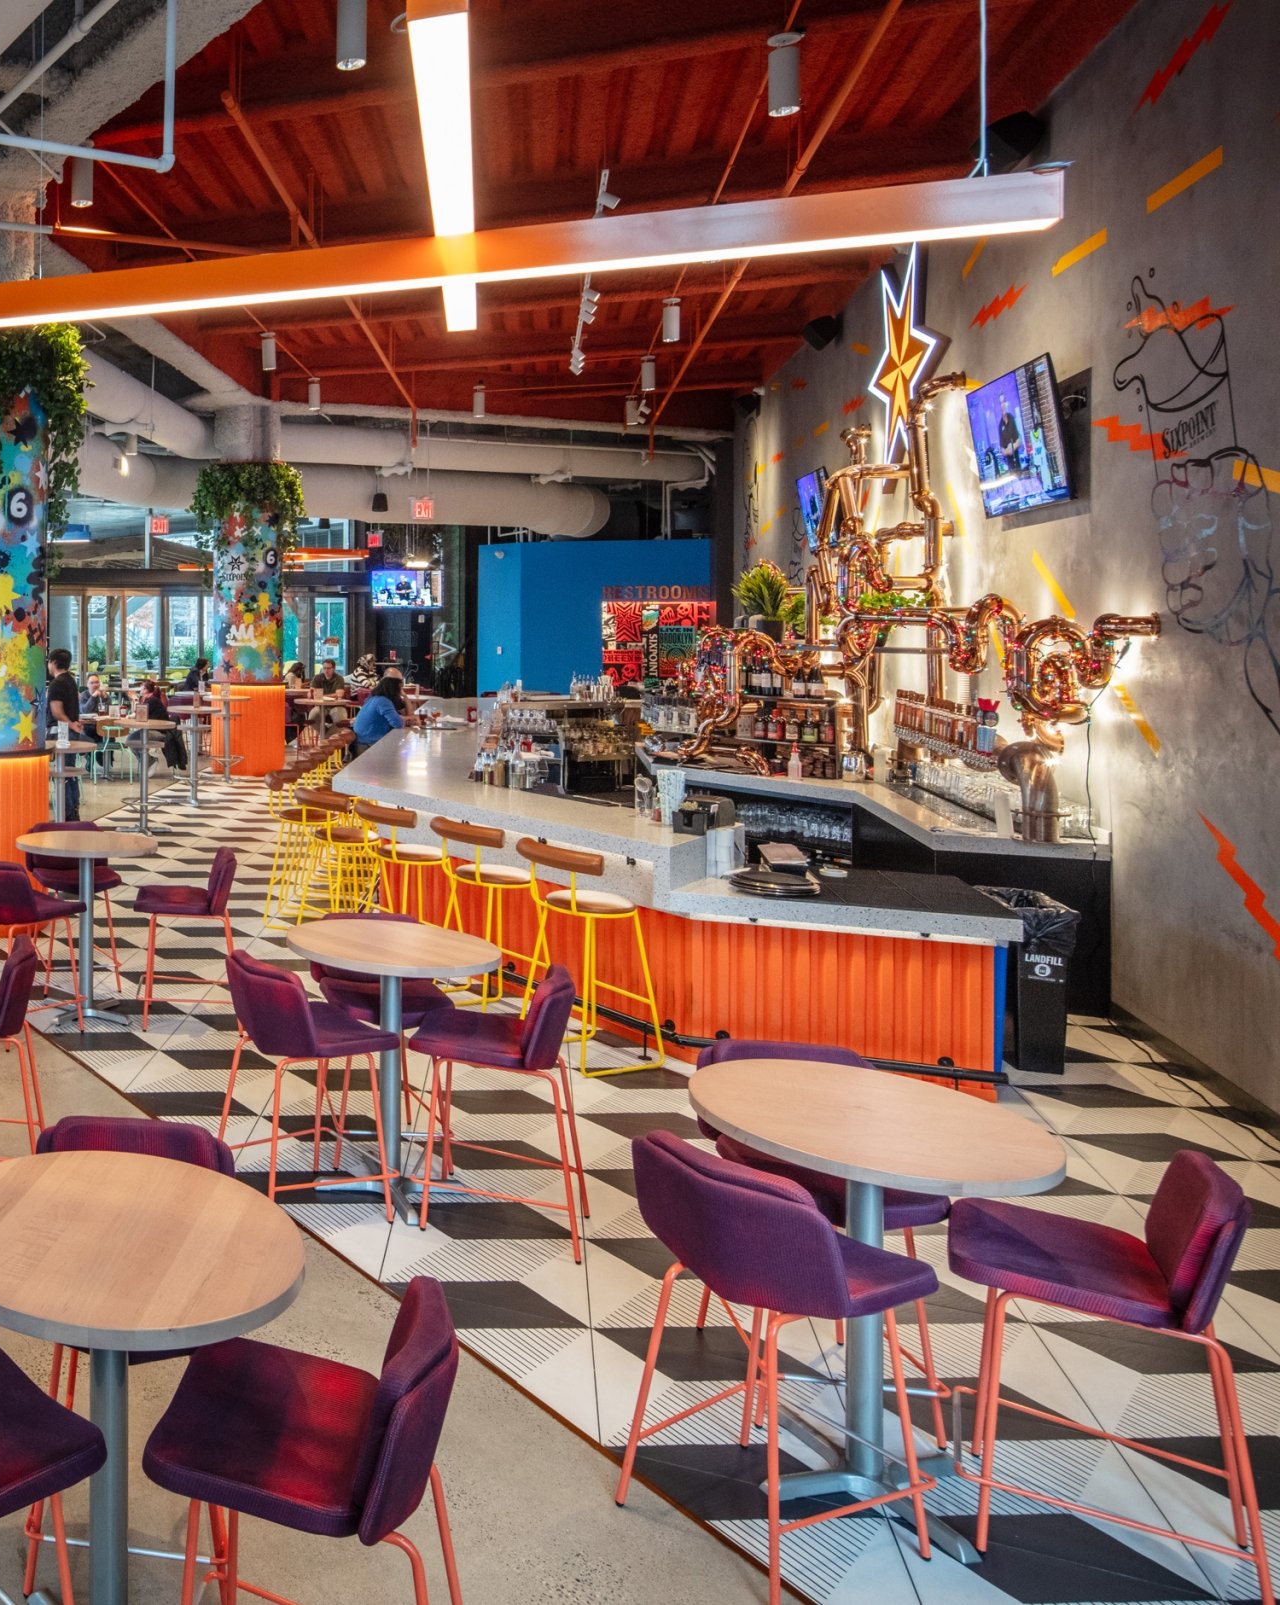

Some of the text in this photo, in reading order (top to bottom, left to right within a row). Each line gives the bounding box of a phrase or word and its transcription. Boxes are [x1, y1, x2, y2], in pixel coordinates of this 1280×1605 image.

[1161, 401, 1217, 459] SIXPOINT
[10, 492, 27, 518] 6
[415, 501, 432, 518] EXIT
[266, 550, 276, 565] 6
[602, 584, 711, 601] RESTROOMS
[649, 633, 658, 677] SIXPOINT
[1025, 953, 1063, 966] LANDFILL
